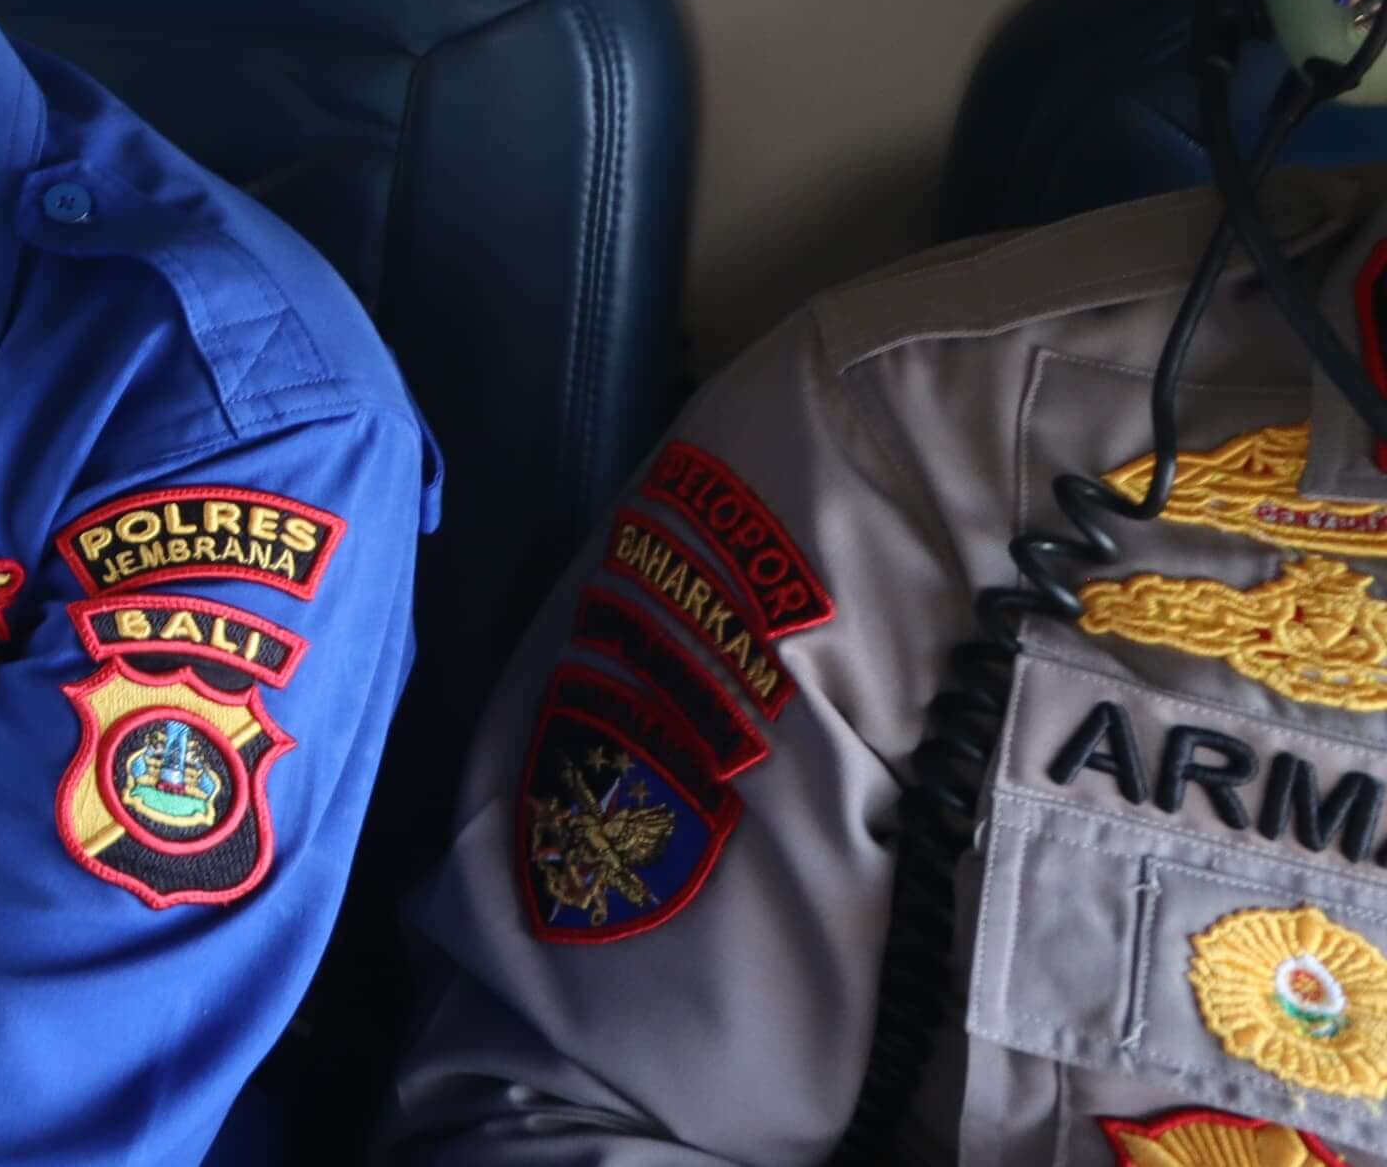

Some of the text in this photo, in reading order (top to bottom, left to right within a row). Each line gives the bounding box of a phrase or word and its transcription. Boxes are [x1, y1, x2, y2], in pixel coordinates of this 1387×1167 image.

[79, 499, 318, 562] POLRES
[102, 536, 297, 583] JEMBRANA
[661, 452, 811, 620] PELOPOR
[114, 608, 261, 662] BALI
[615, 523, 780, 699] BAHARKAM
[1047, 699, 1387, 868] ARM
